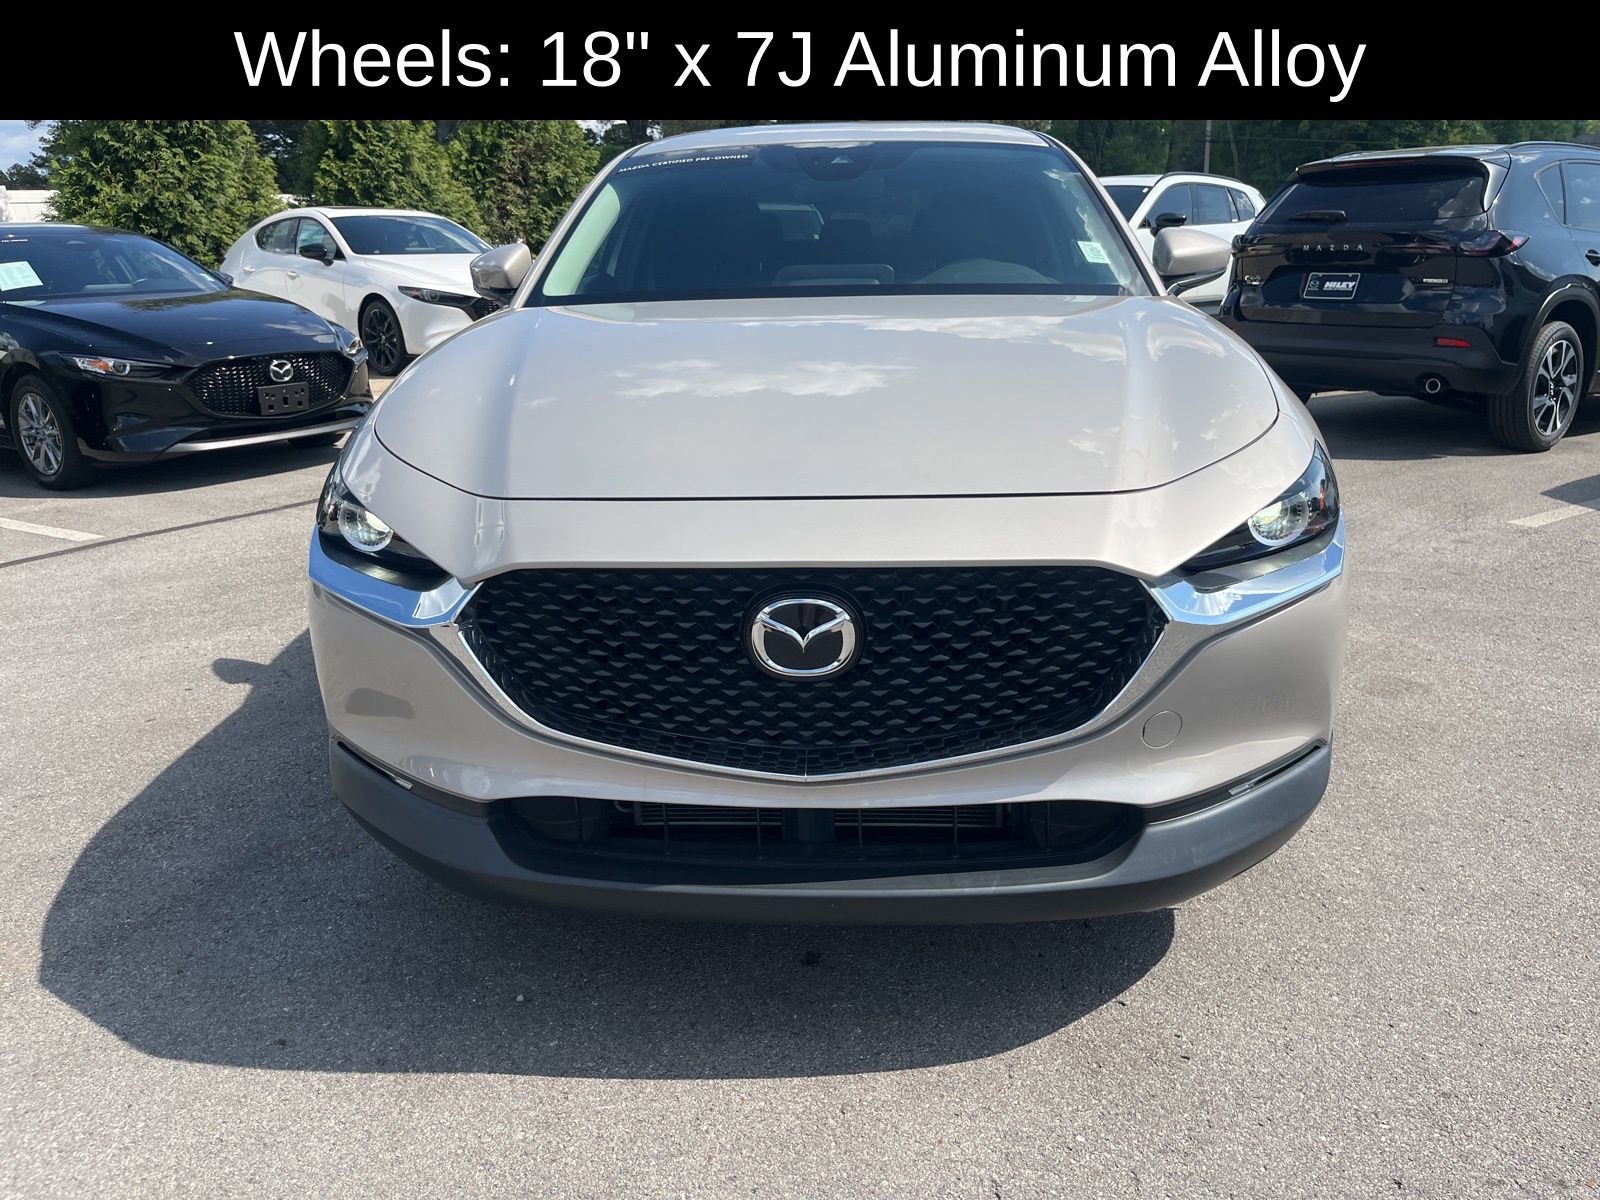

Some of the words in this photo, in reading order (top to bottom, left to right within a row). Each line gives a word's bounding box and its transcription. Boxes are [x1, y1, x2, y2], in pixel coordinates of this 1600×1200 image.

[618, 163, 650, 174] MAZDA
[652, 158, 694, 167] CERTIFIED
[696, 154, 749, 162] PRE-OWNED
[1302, 244, 1363, 252] MAZDA
